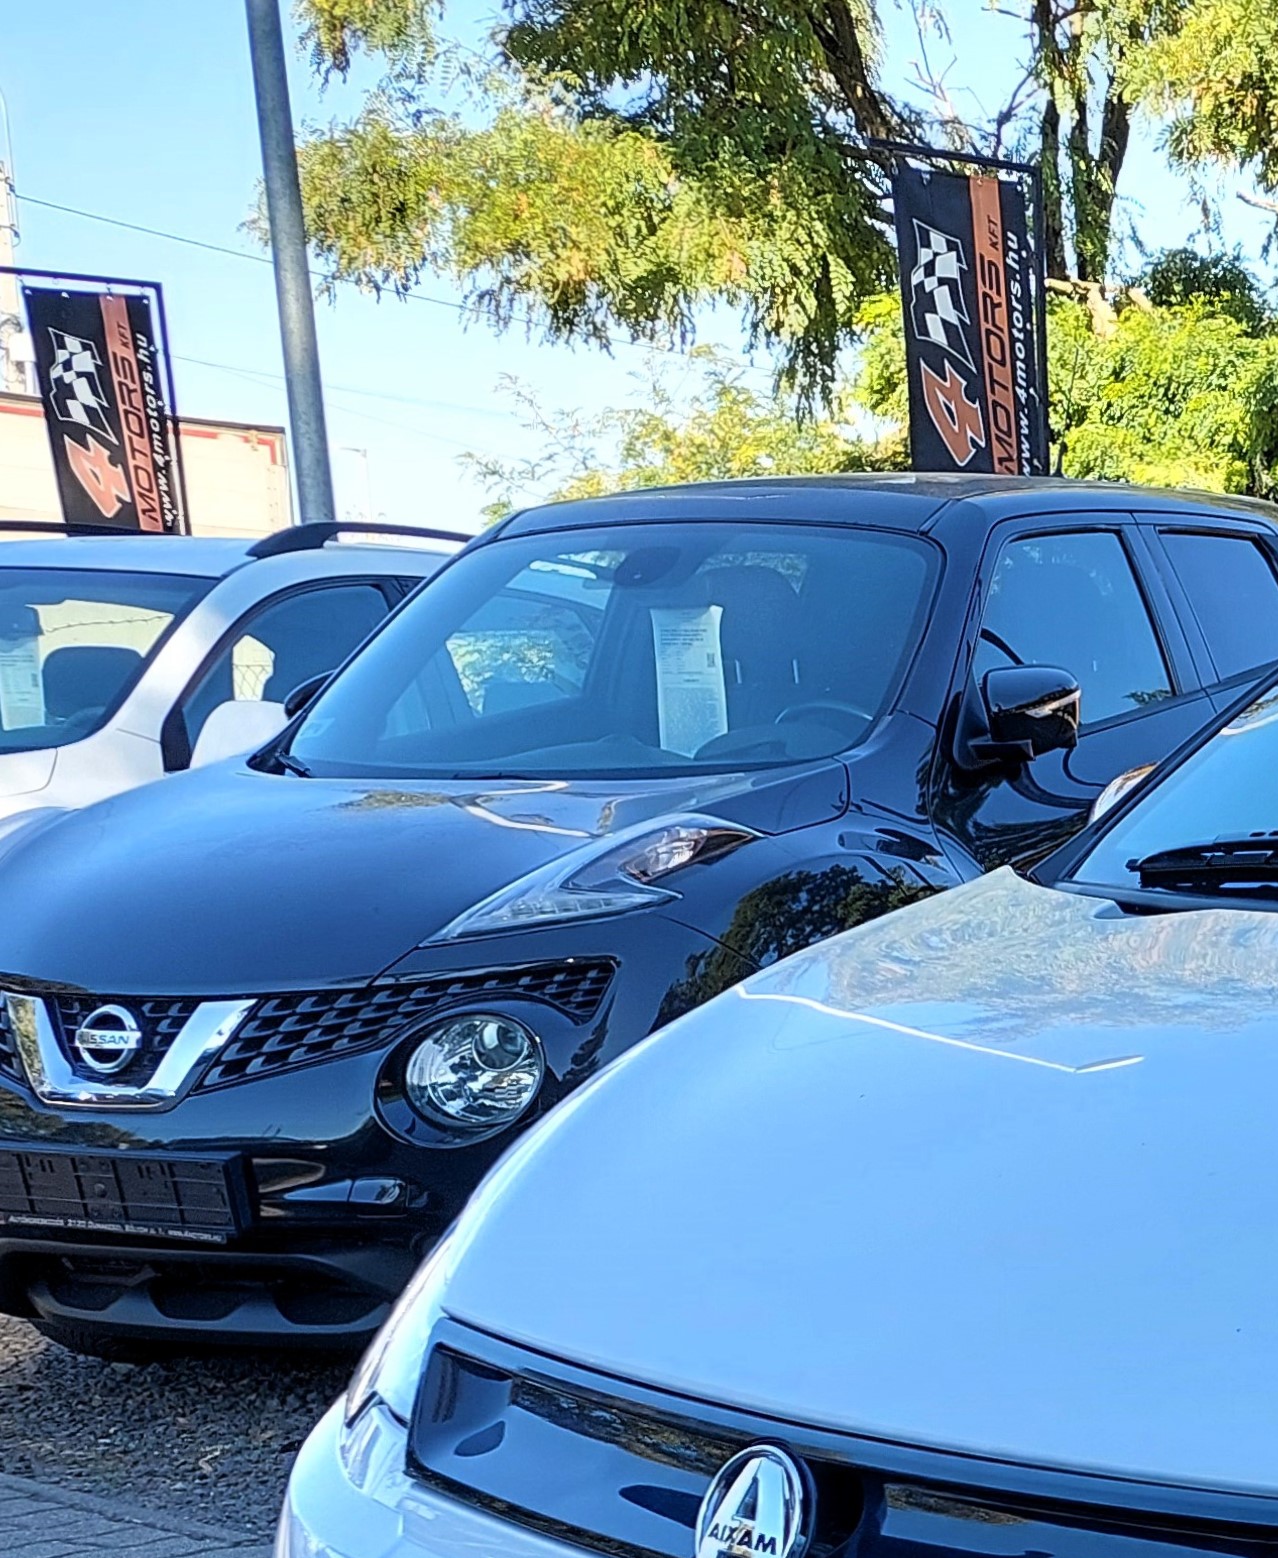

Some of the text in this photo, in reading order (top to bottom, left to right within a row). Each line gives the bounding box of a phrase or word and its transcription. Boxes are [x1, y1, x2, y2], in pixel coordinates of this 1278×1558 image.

[979, 214, 1015, 475] MOTORS KFT
[111, 322, 160, 524] MOTORS KFT
[920, 357, 985, 467] 4
[63, 434, 132, 519] 4
[708, 1523, 778, 1556] AIXAM
